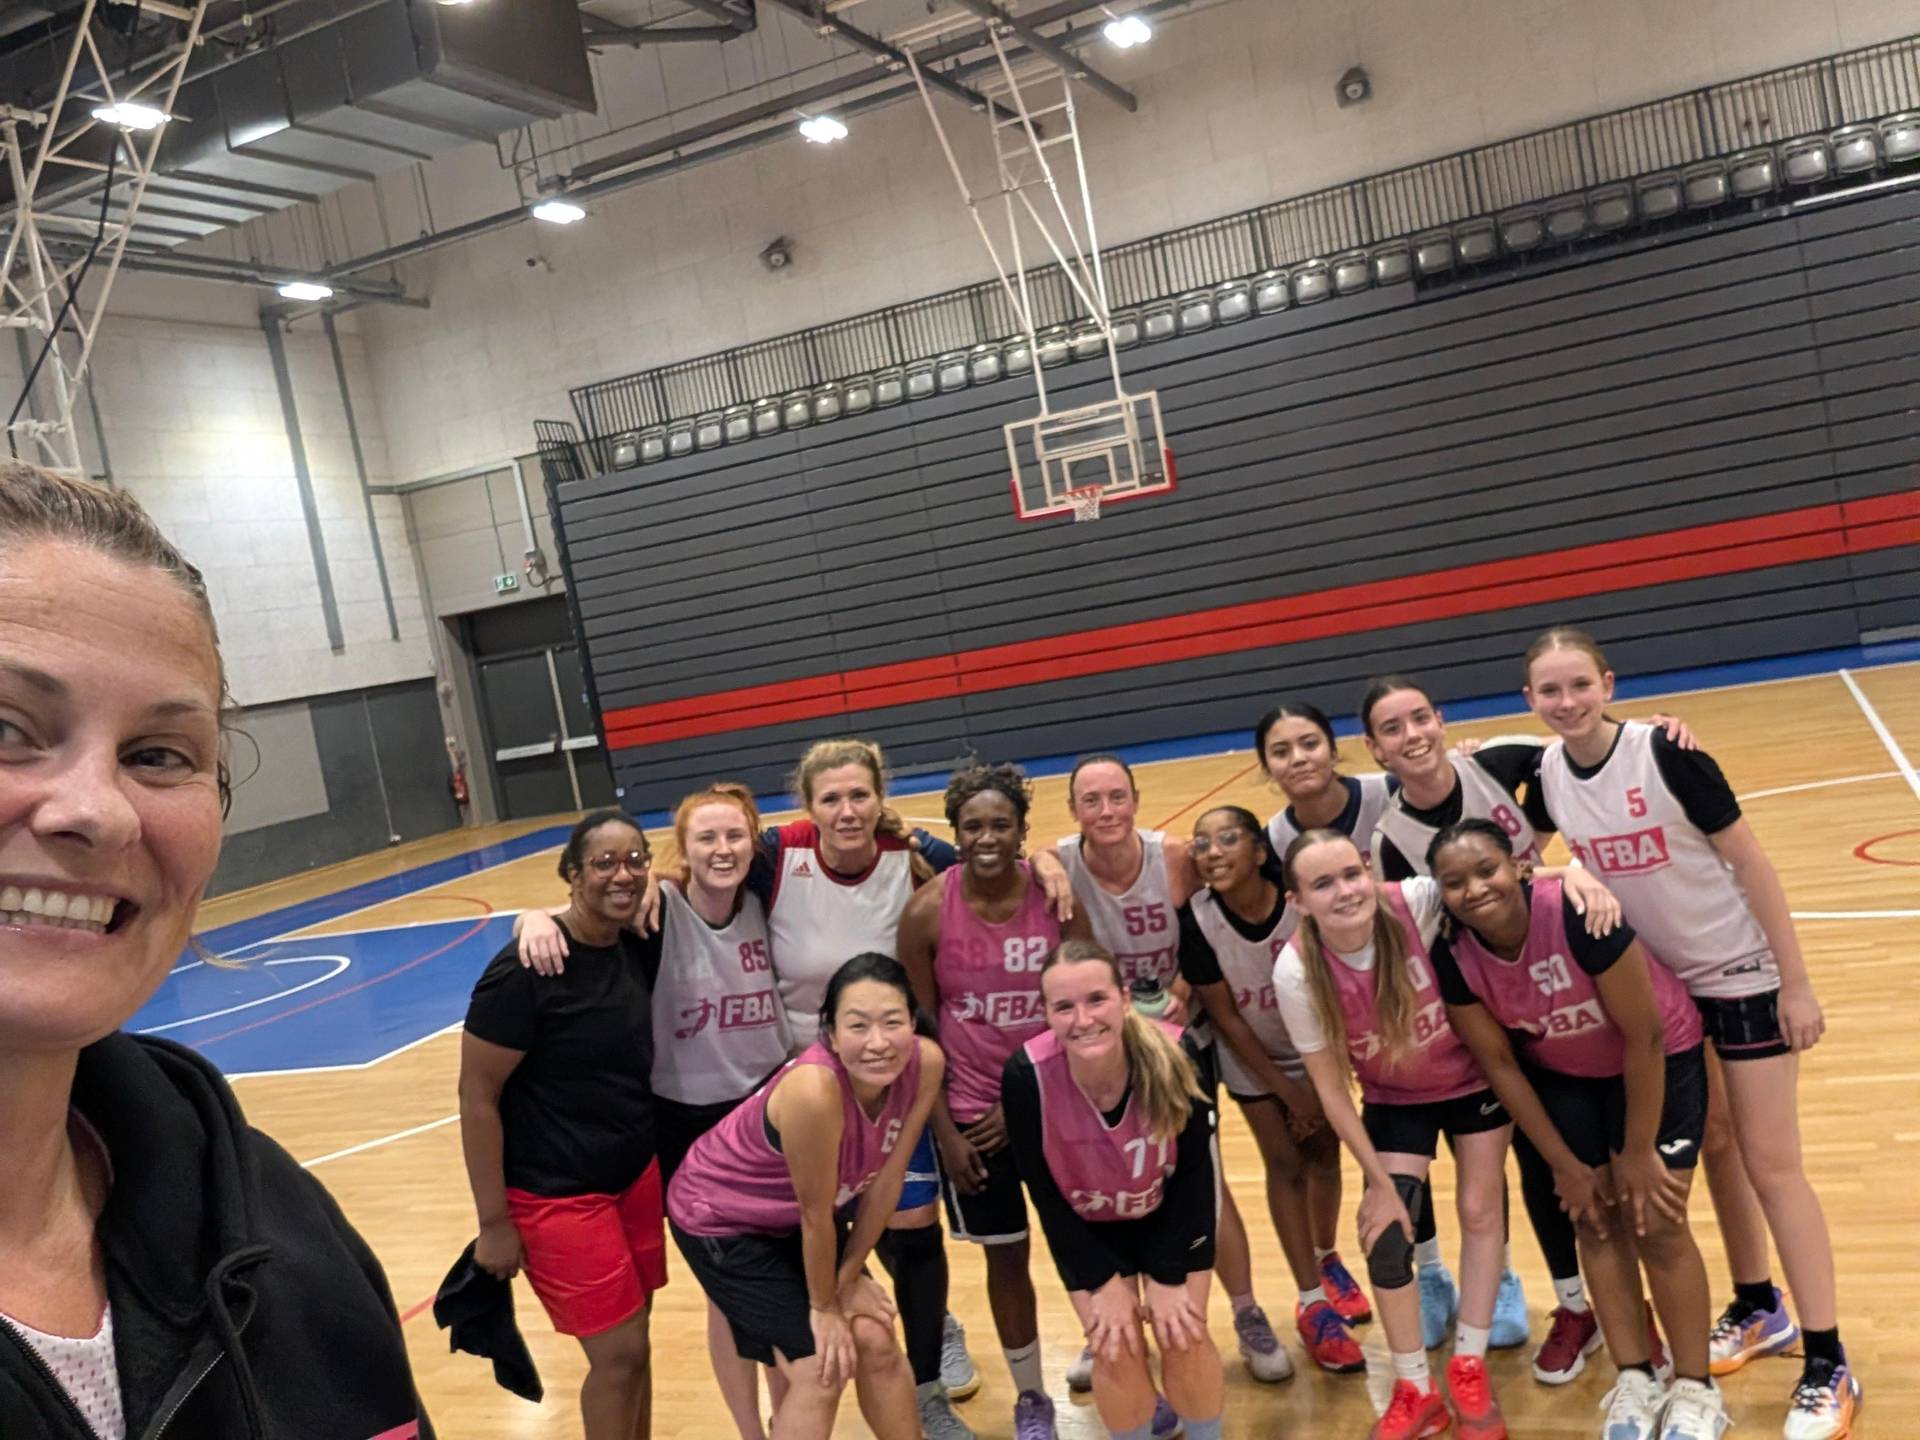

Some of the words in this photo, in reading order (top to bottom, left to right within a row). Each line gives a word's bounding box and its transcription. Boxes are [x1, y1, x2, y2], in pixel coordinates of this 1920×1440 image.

[1626, 787, 1648, 818] 5
[1492, 804, 1522, 837] 8
[1599, 833, 1662, 867] FBA
[1123, 902, 1168, 936] 55
[738, 938, 770, 973] 85
[1003, 936, 1047, 973] 82
[1119, 951, 1171, 980] FBA
[1528, 953, 1573, 996] 50
[725, 993, 775, 1025] FBA
[1416, 1006, 1446, 1042] BA
[1548, 1007, 1599, 1033] BA
